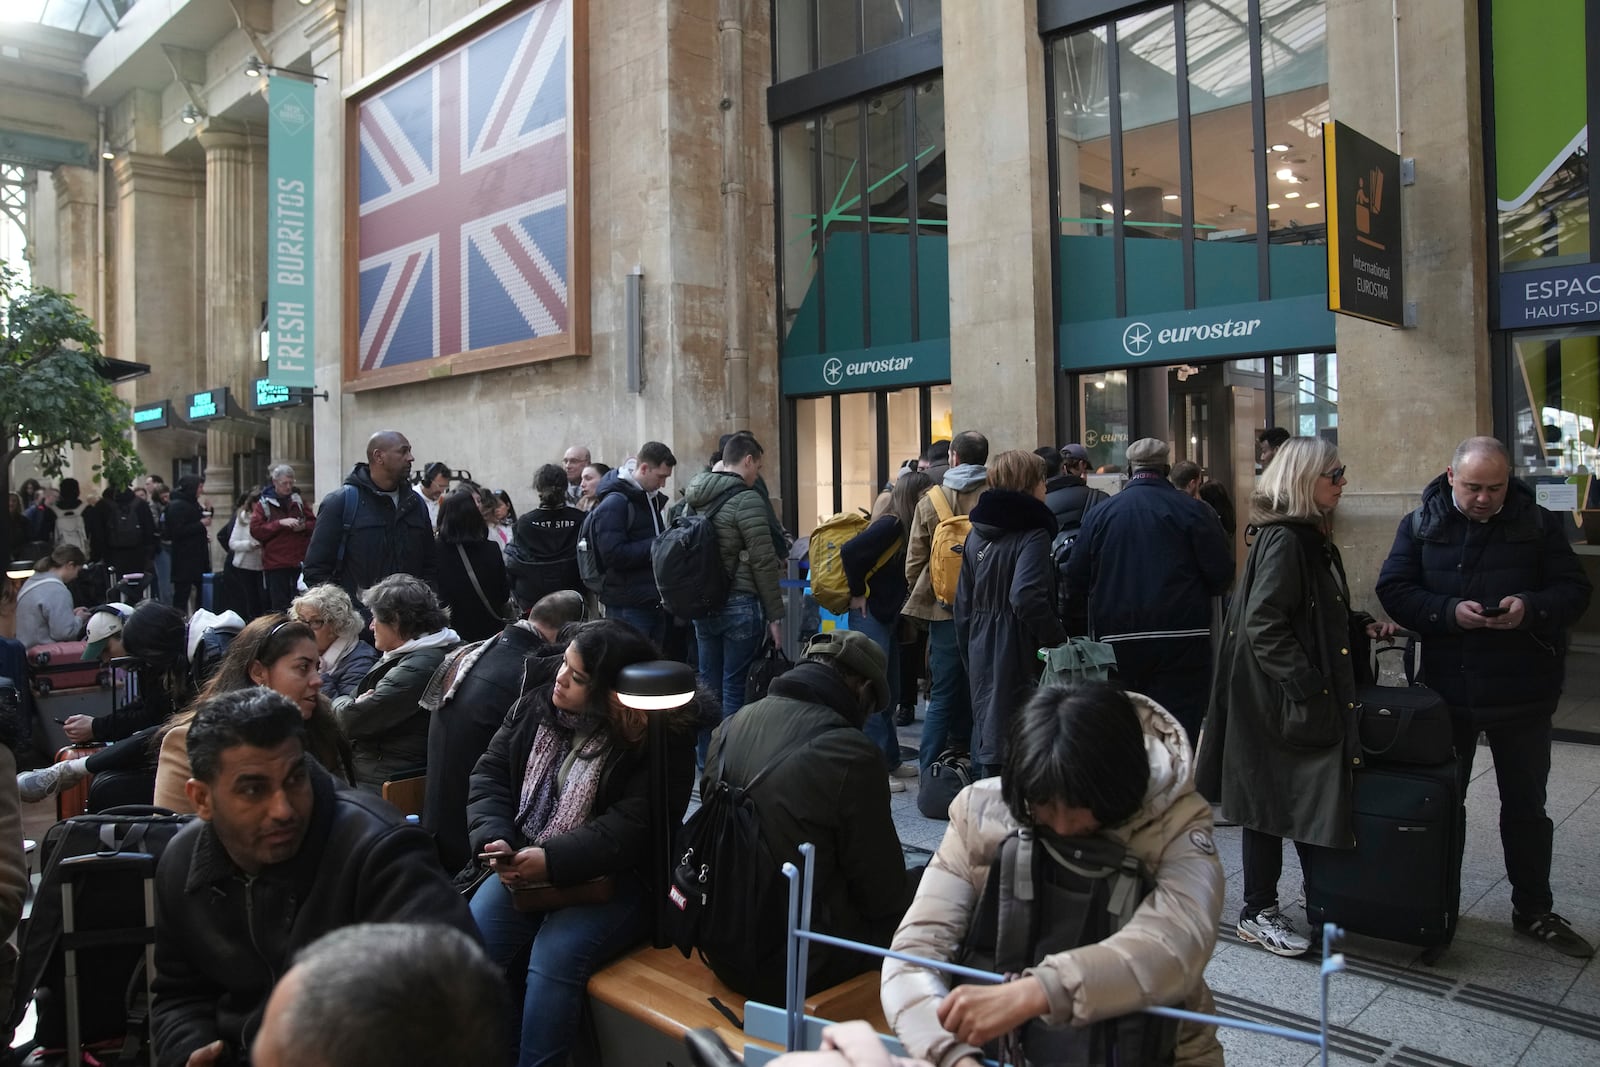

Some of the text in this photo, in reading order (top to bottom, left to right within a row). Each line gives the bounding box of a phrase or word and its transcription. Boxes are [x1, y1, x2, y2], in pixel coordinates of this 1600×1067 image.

[1352, 254, 1391, 280] International
[1356, 277, 1389, 300] EUROSTAR
[1525, 301, 1600, 319] HAUTS-D
[277, 302, 305, 371] FRESH
[1157, 318, 1261, 344] eurostar
[846, 356, 914, 376] eurostar
[1100, 432, 1129, 443] euro
